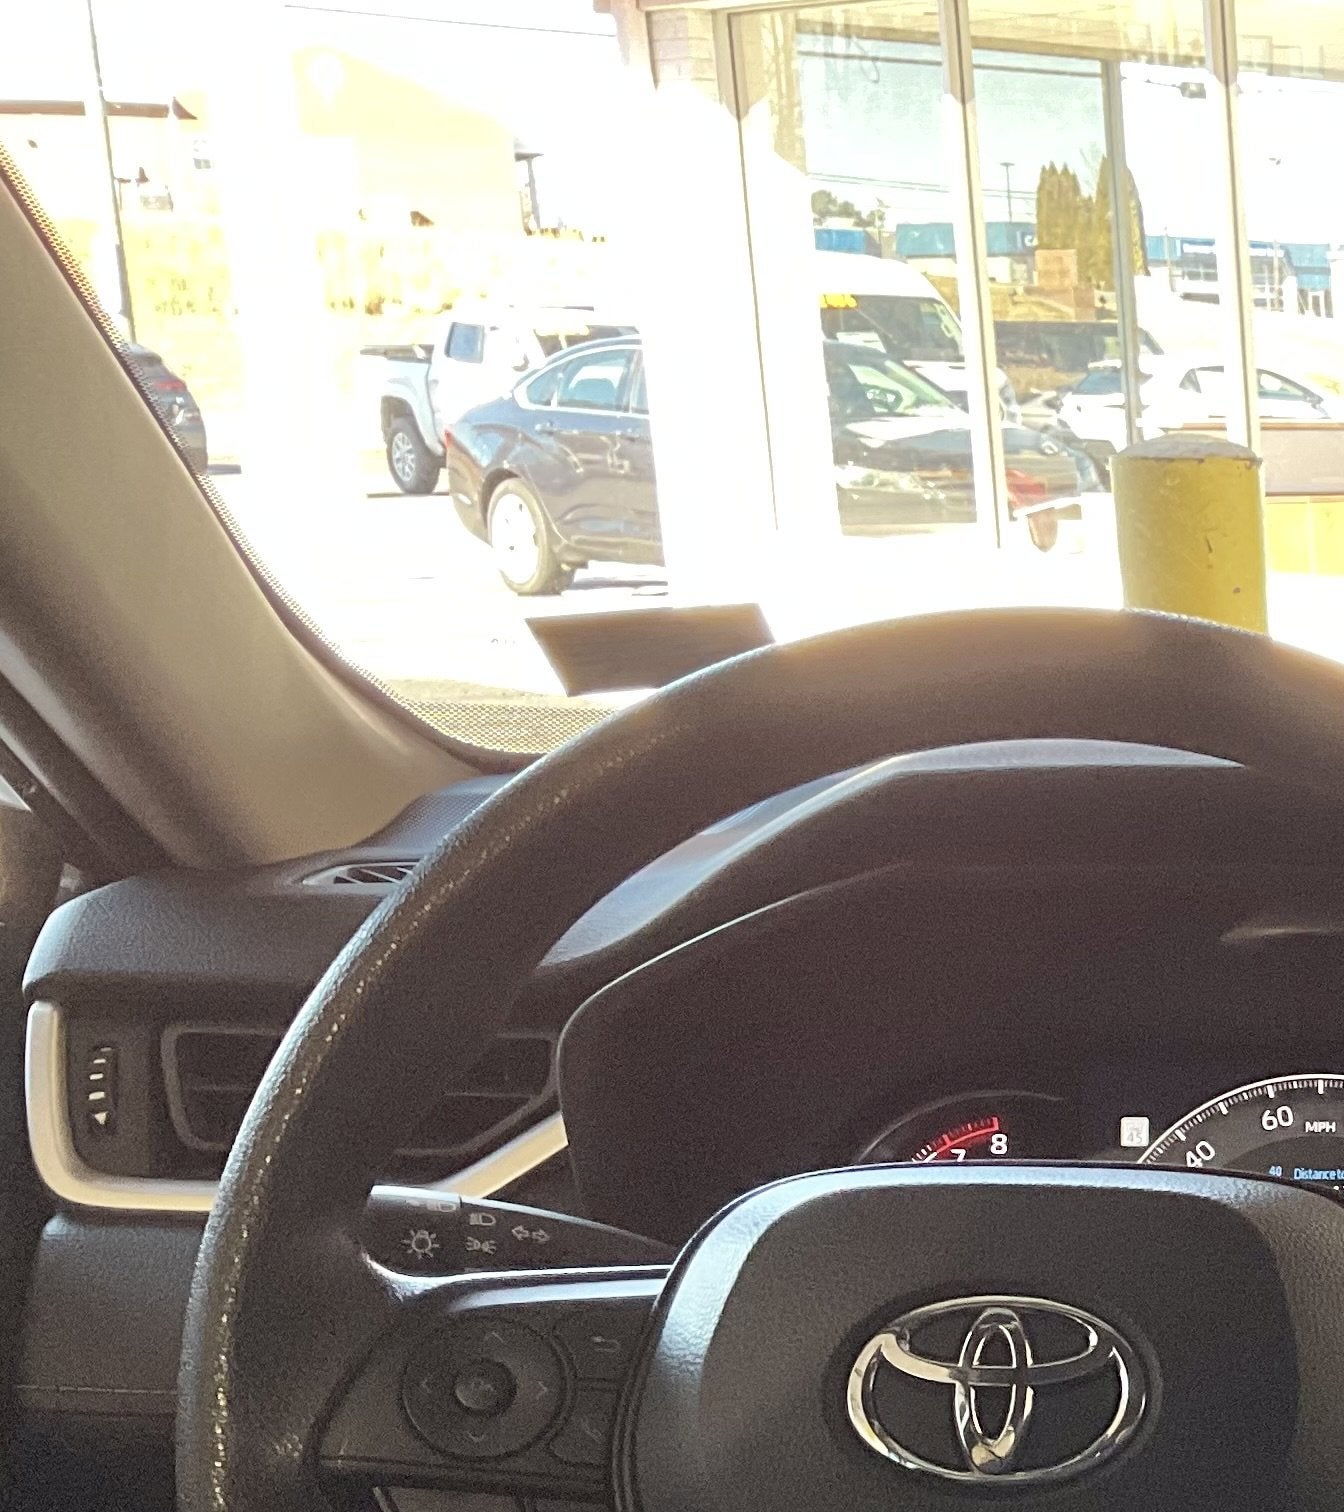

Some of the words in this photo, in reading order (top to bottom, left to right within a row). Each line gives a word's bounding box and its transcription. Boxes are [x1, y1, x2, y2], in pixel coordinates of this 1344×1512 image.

[1261, 1105, 1294, 1132] 60
[1304, 1120, 1337, 1134] MPH
[990, 1133, 1008, 1155] 8
[1184, 1140, 1216, 1169] 40
[1294, 1168, 1336, 1181] Distance
